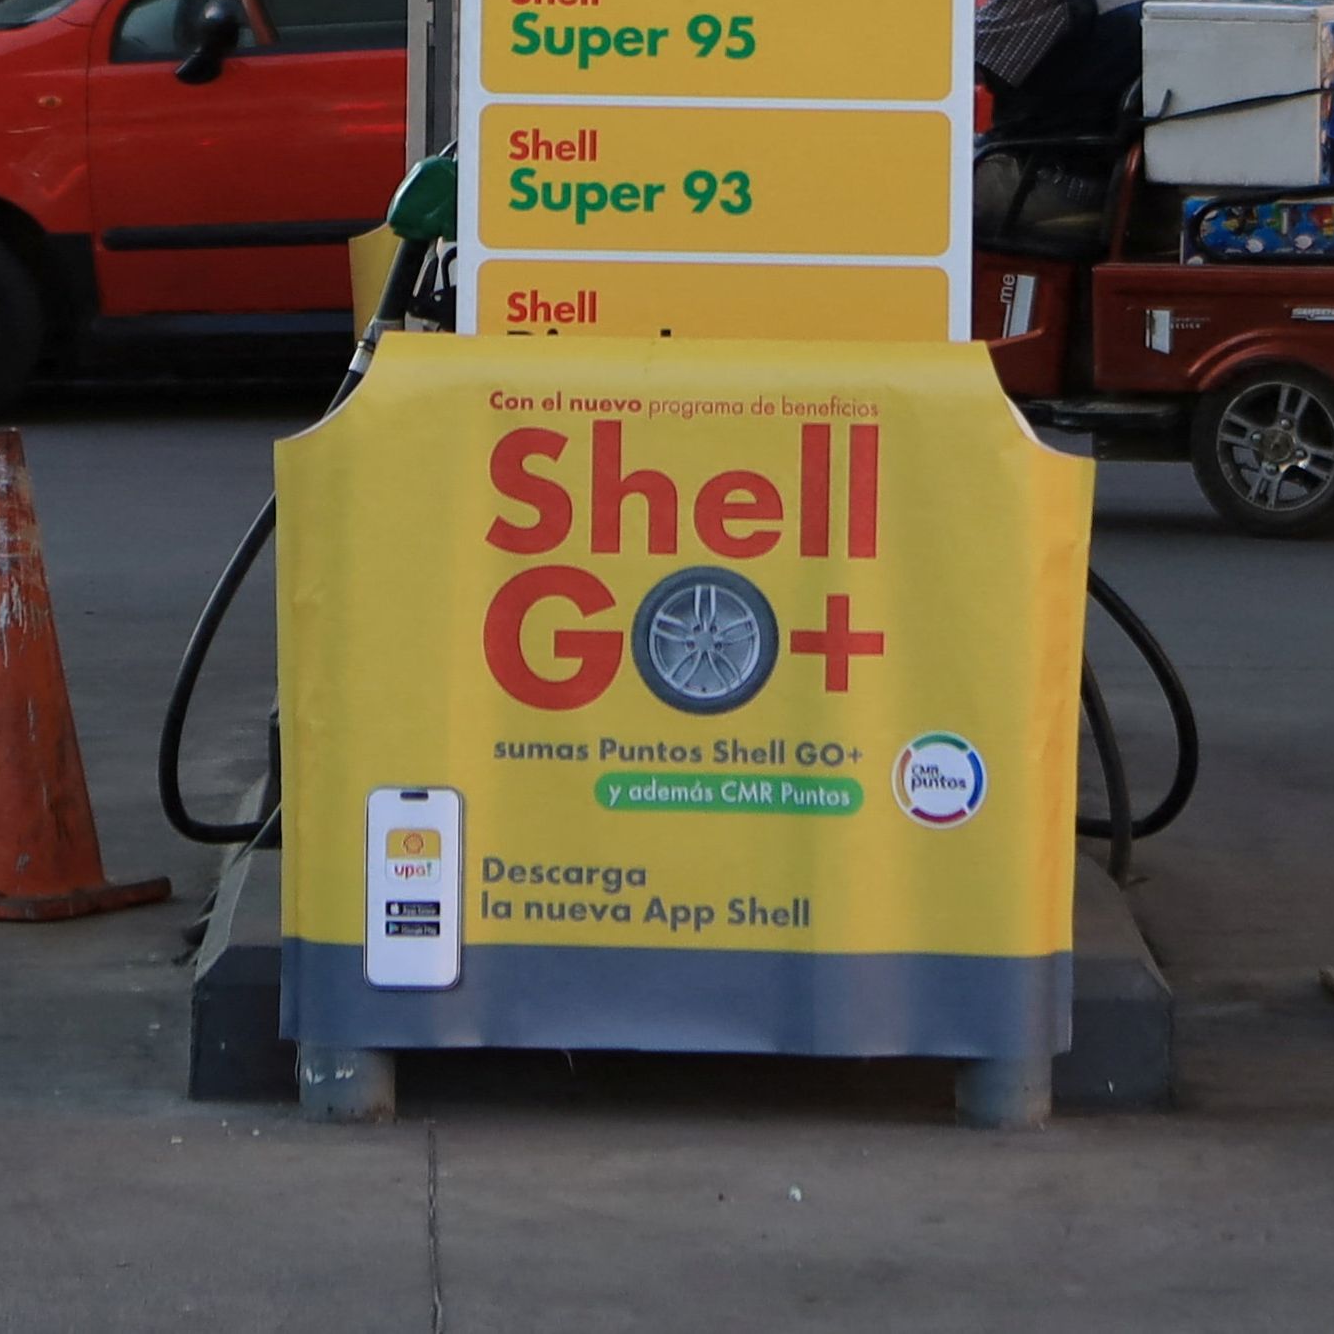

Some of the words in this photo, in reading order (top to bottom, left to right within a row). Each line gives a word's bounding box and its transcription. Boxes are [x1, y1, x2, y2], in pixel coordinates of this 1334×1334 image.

[510, 11, 669, 70] Super
[686, 13, 757, 60] 95
[508, 129, 598, 162] Shell
[508, 167, 665, 225] Super
[682, 169, 753, 215] 93
[506, 290, 598, 324] Shell
[490, 390, 535, 414] Con
[541, 391, 565, 413] el
[569, 397, 642, 414] nuevo
[648, 397, 744, 421] programa
[750, 394, 776, 418] de
[781, 394, 879, 419] beneficios
[485, 419, 880, 560] Shell
[493, 740, 590, 762] sumas
[598, 738, 703, 765] Puntos
[712, 739, 787, 767] Shell
[794, 742, 864, 768] GO+
[608, 785, 622, 807] y
[628, 779, 712, 804] además
[722, 781, 773, 805] CMR
[780, 783, 851, 808] Puntos
[911, 775, 967, 792] puntos
[481, 856, 647, 895] Descarga
[481, 891, 514, 922] la
[523, 900, 631, 924] nueva
[642, 894, 716, 933] App
[727, 896, 811, 929] Shell
